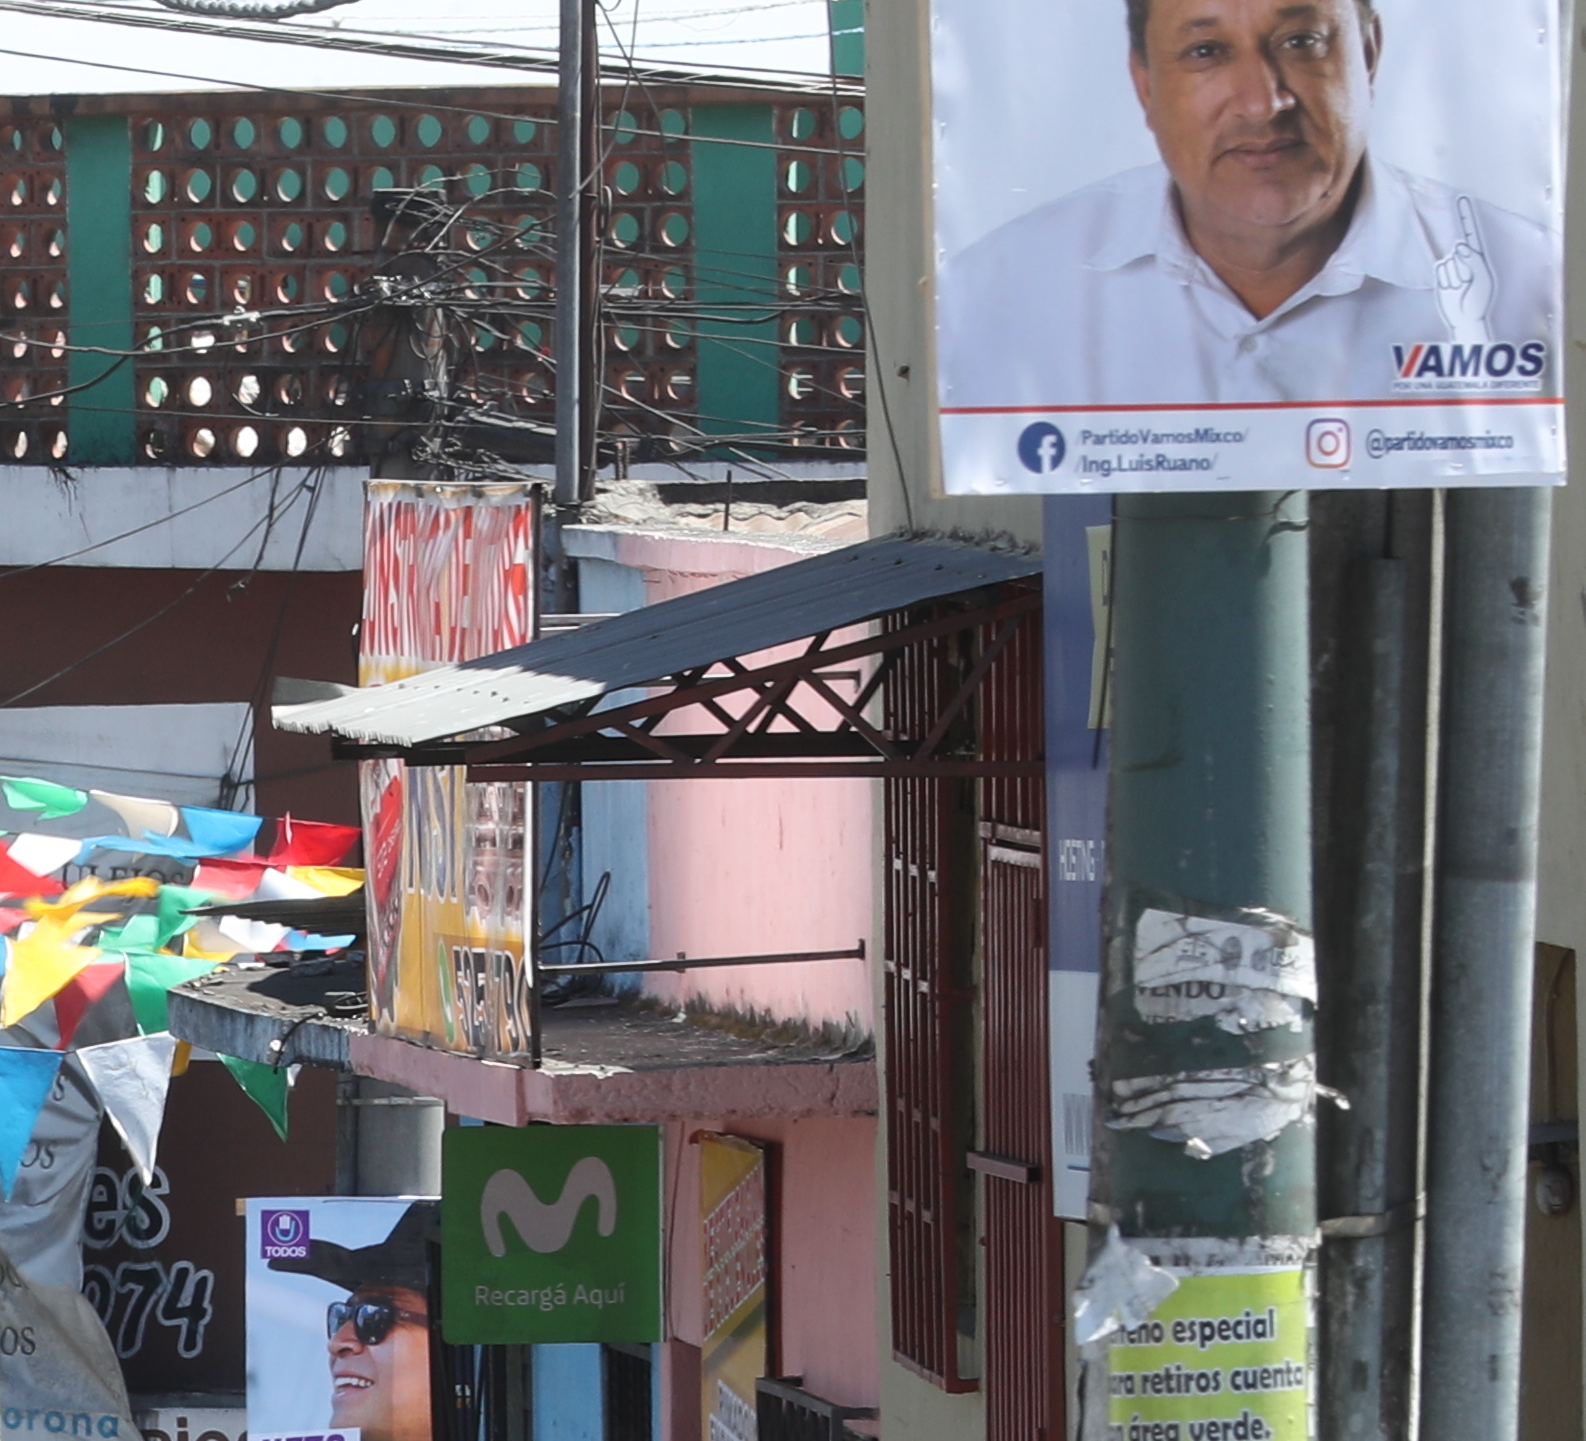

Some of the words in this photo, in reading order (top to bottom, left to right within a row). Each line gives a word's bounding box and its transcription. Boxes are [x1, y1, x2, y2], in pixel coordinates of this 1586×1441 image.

[1392, 343, 1545, 378] VAMOS
[265, 1245, 307, 1258] TODOS
[474, 1283, 567, 1312] Recargá
[572, 1282, 626, 1313] Aquí
[1172, 1306, 1275, 1349] especial
[1141, 1364, 1222, 1395] retiros
